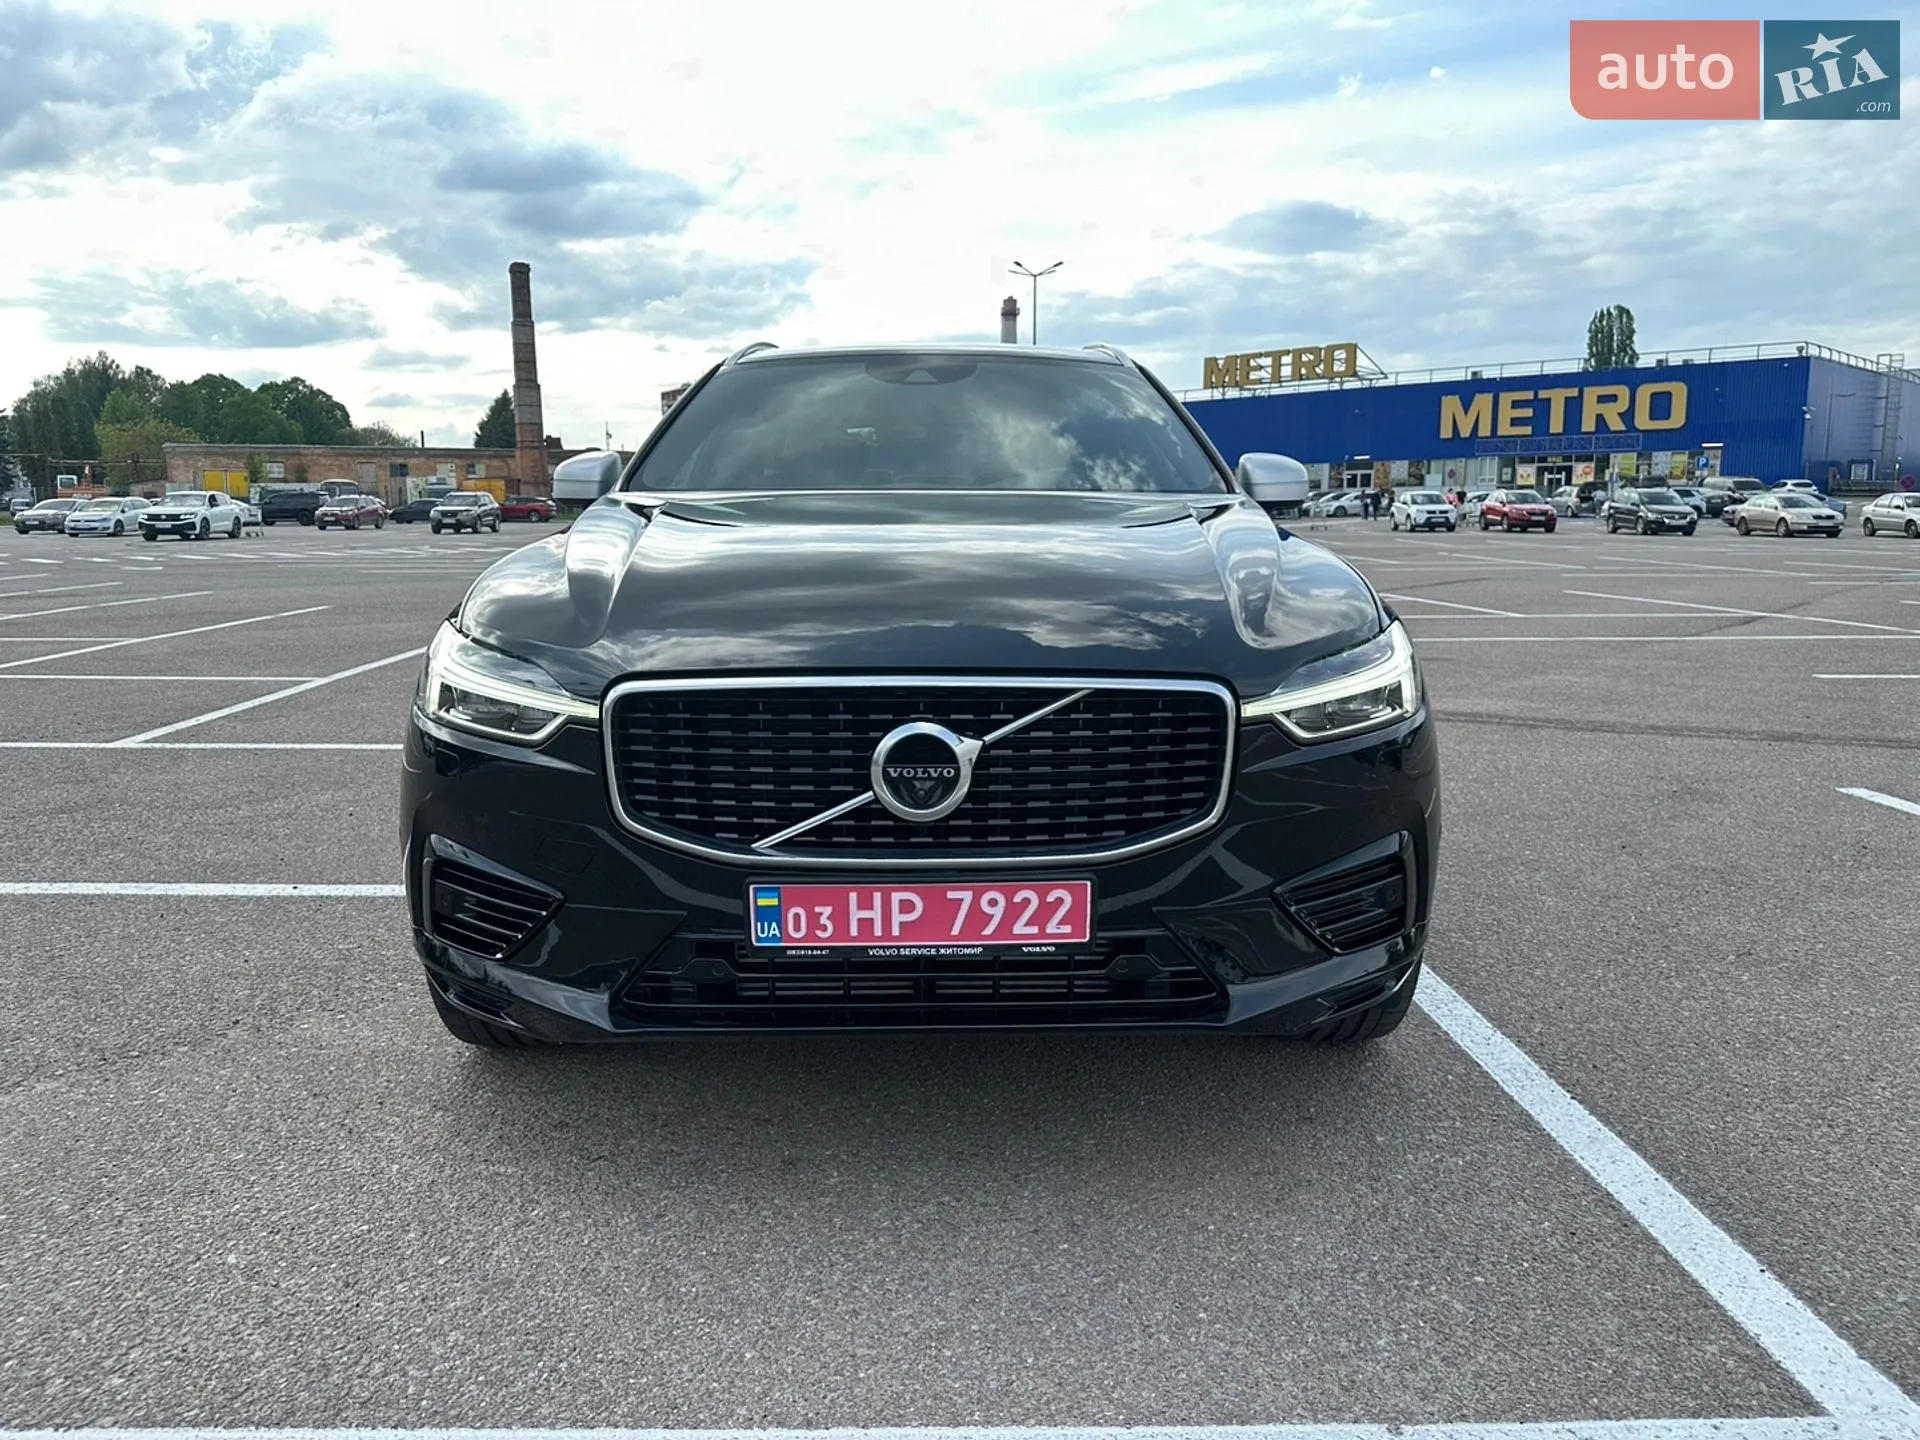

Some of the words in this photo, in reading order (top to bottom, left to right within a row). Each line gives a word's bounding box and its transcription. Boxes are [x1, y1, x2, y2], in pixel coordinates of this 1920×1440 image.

[1203, 342, 1358, 389] METRO
[1439, 381, 1688, 439] METRO
[886, 767, 955, 778] VOLVO
[757, 921, 781, 938] UA
[786, 906, 834, 939] 03
[849, 891, 924, 937] HP
[946, 889, 1073, 936] 7922
[868, 948, 897, 956] VOLVO
[899, 947, 937, 956] SERVICE
[938, 946, 983, 956] ЖИТОМИР
